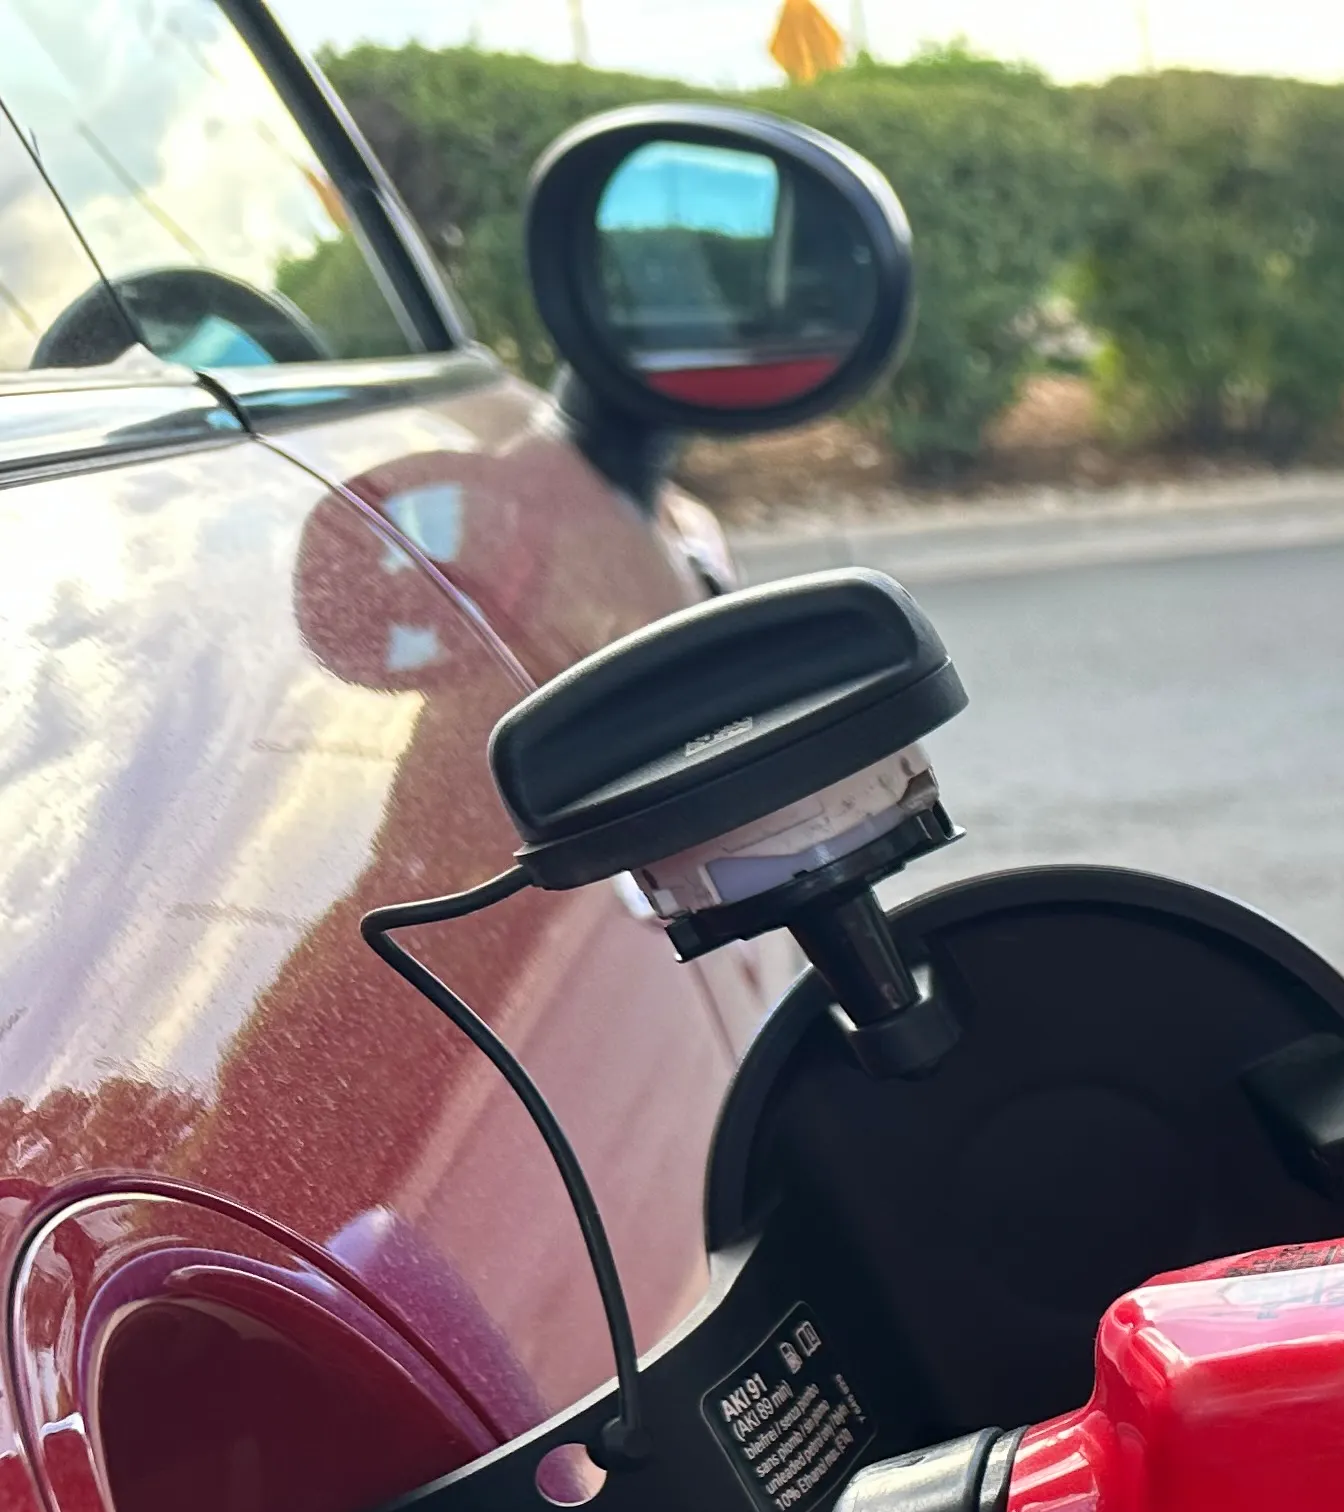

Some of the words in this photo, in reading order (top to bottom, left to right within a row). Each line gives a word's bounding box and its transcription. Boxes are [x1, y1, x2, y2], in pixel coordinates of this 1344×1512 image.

[722, 1386, 752, 1422] AKI
[745, 1372, 768, 1400] 91
[732, 1409, 761, 1442] (AKI
[756, 1397, 775, 1420] 89
